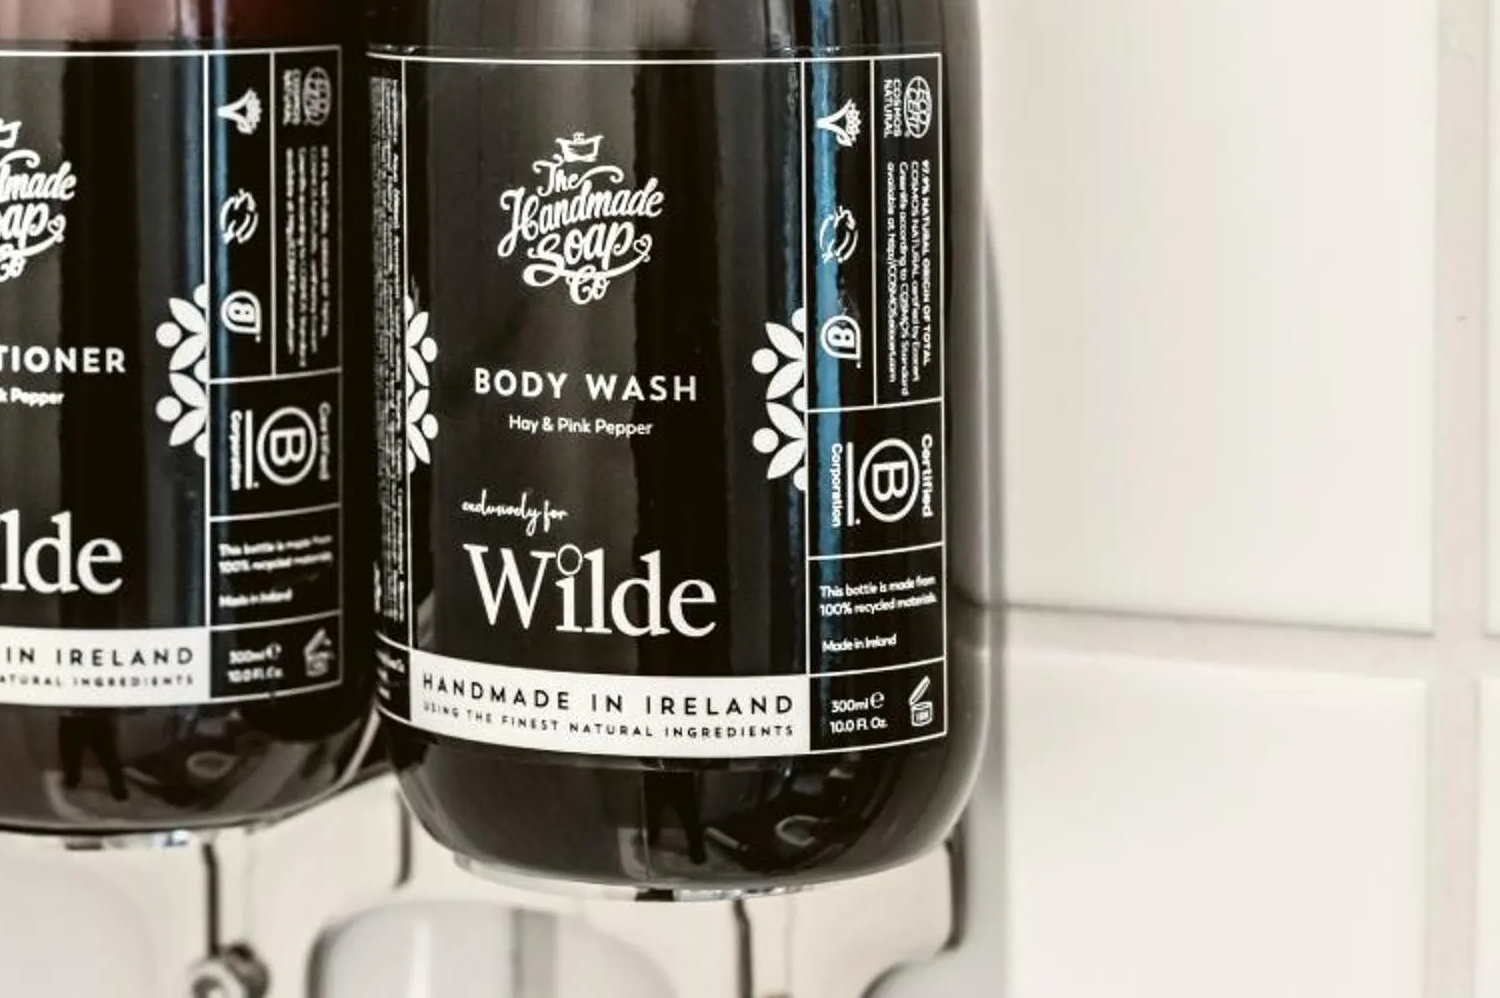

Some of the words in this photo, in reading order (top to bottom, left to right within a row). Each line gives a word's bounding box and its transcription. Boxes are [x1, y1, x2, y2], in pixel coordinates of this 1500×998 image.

[884, 78, 893, 139] NATURAL
[498, 177, 665, 257] Handmade
[522, 222, 652, 287] Soap
[922, 324, 931, 367] TOTAL
[474, 367, 568, 399] BODY
[585, 373, 697, 401] WASH
[509, 414, 538, 434] Hay
[542, 415, 554, 432] &
[557, 417, 591, 434] Pink
[595, 419, 653, 438] Pepper
[830, 442, 844, 528] Corporation
[921, 433, 933, 518] Certified
[462, 543, 717, 637] Wilde
[820, 585, 844, 598] This
[845, 582, 878, 597] bottle
[820, 602, 853, 617] 100%
[854, 597, 895, 615] recycled
[7, 646, 35, 664] IN
[56, 647, 194, 667] IRELAND
[821, 638, 853, 652] Made
[865, 633, 897, 649] Ireland
[422, 673, 570, 711] HANDMADE
[591, 693, 623, 713] IN
[646, 695, 793, 716] IRELAND
[831, 698, 869, 713] 300ml
[466, 709, 493, 724] THE
[501, 714, 559, 731] FINEST
[569, 722, 653, 737] NATURAL
[665, 725, 793, 739] INGREDIENTS
[830, 719, 854, 734] 10.0
